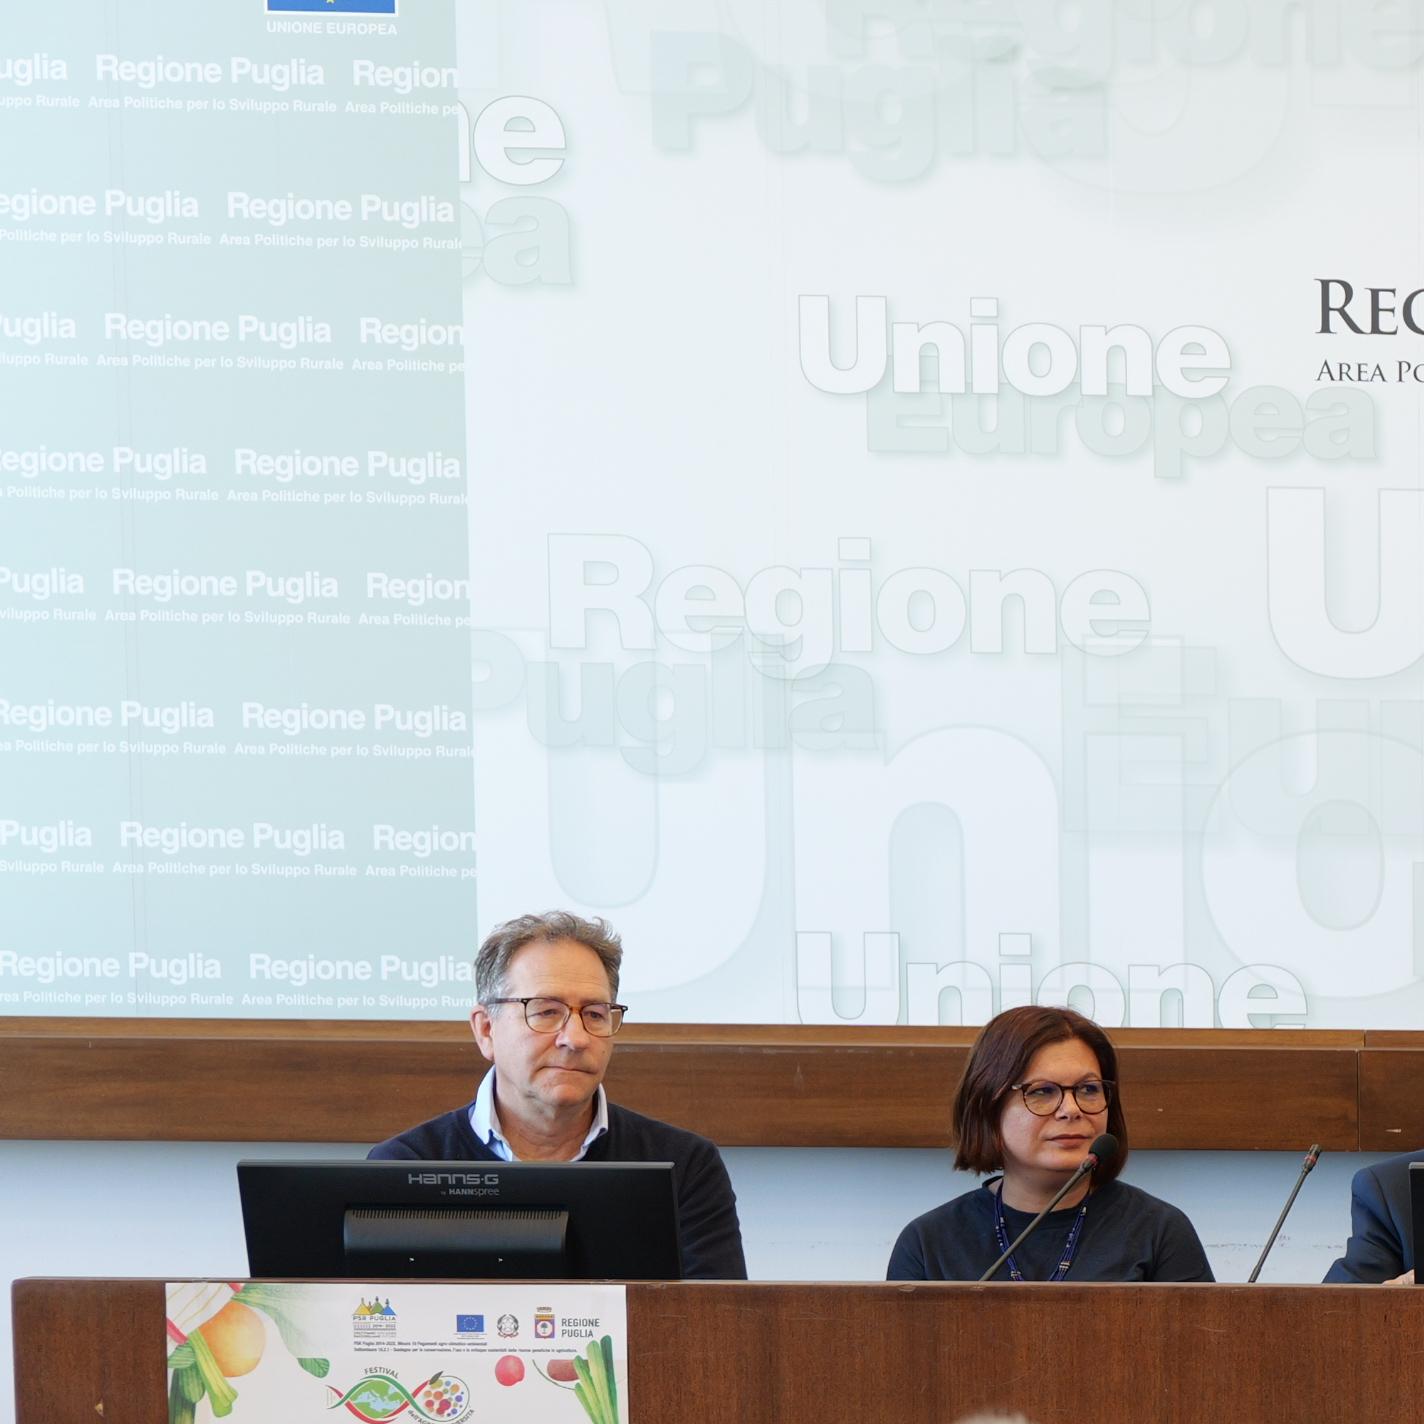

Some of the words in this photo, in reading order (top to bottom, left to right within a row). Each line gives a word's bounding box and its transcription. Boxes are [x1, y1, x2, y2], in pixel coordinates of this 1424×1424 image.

[267, 20, 322, 33] UNIONE
[326, 22, 397, 35] EUROPEA
[96, 54, 222, 89] Regione
[231, 57, 324, 91] Puglia
[88, 96, 121, 108] Area
[124, 96, 184, 109] Politiche
[186, 99, 212, 114] per
[215, 99, 226, 111] lo
[229, 98, 289, 114] Sviluppo
[293, 100, 336, 112] Rurale
[228, 192, 352, 226] Regione
[361, 194, 454, 229] Puglia
[797, 294, 1232, 399] Unione
[866, 356, 1378, 478] Europea
[235, 448, 359, 482] Regione
[368, 451, 460, 485] Puglia
[547, 532, 1152, 681] Regione
[243, 702, 365, 736] Regione
[374, 704, 466, 737] Puglia
[120, 821, 244, 854] Regione
[253, 823, 344, 856] Puglia
[562, 1318, 600, 1327] REGIONE
[562, 1329, 593, 1338] PUGLIA
[363, 1366, 400, 1380] FESTIVAL
